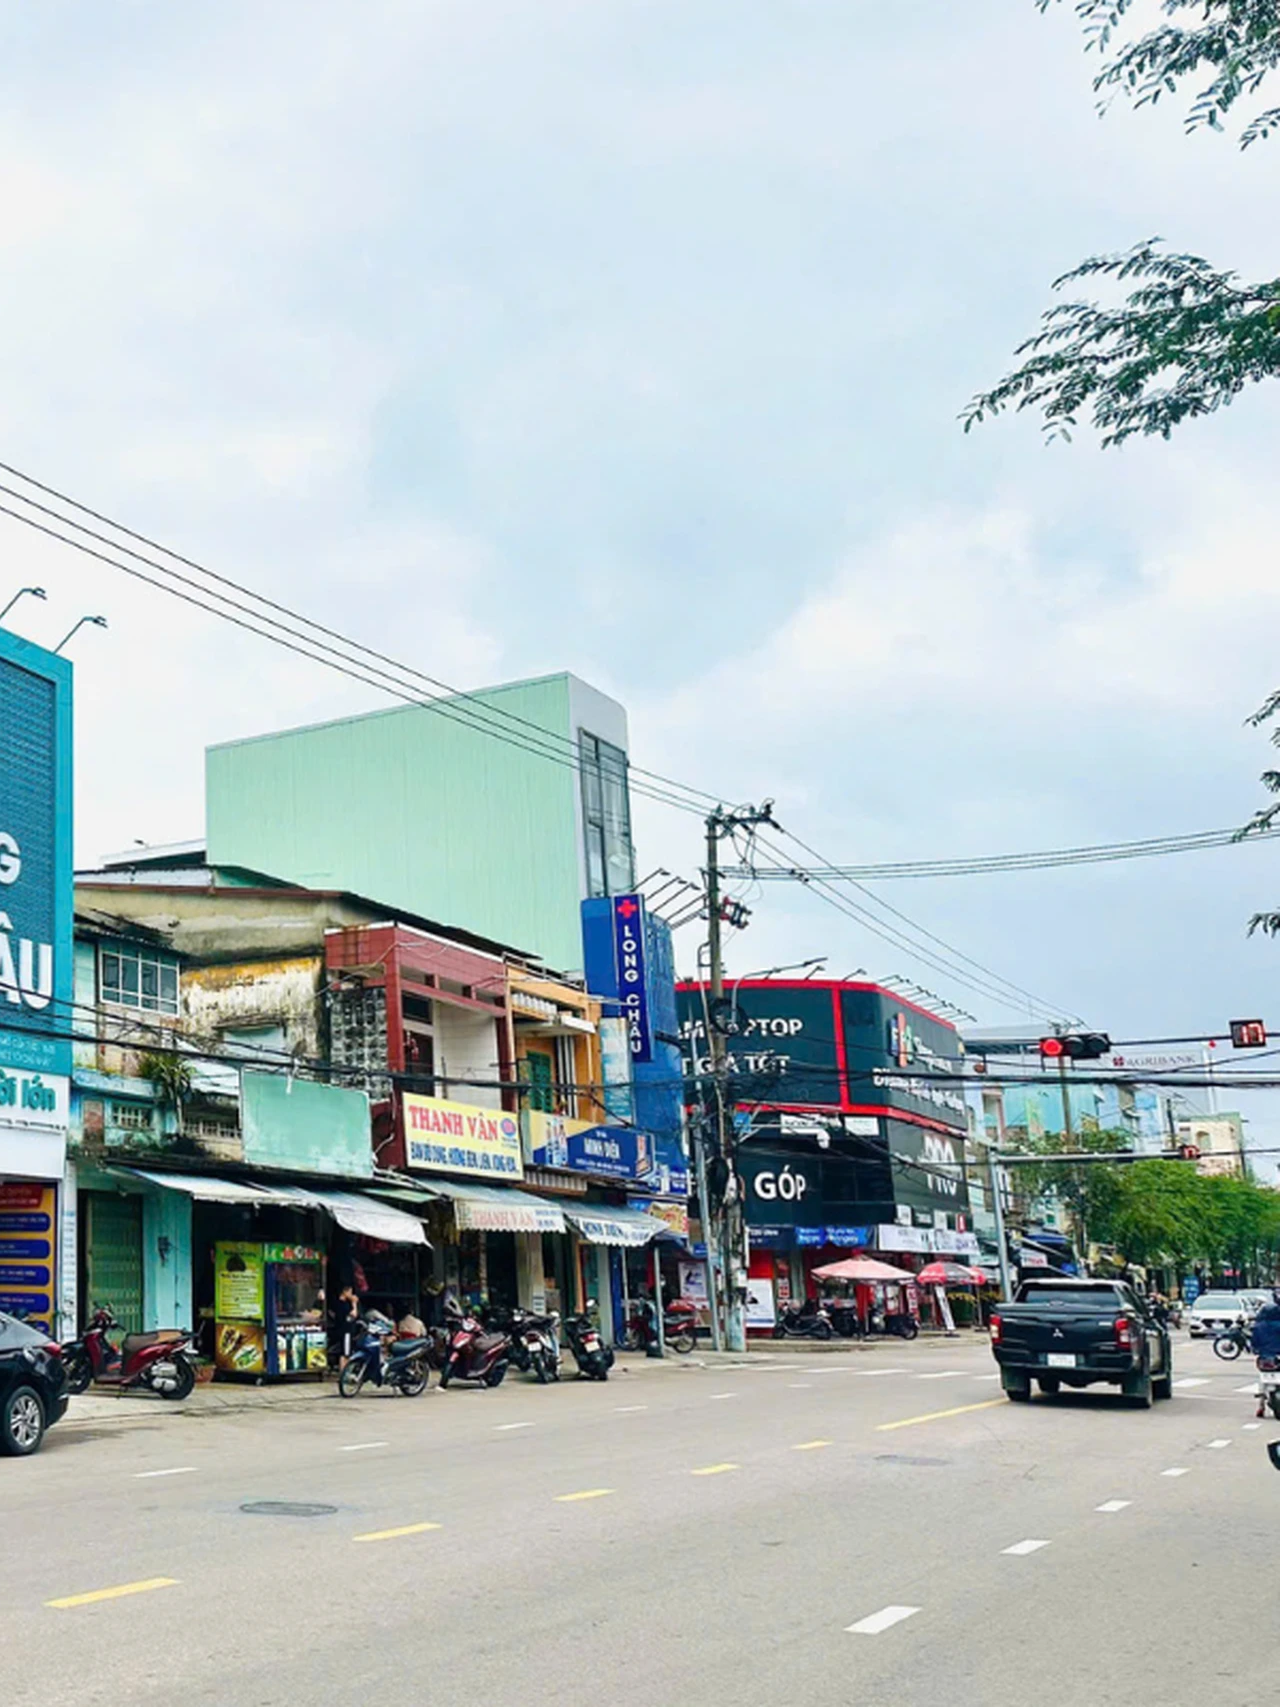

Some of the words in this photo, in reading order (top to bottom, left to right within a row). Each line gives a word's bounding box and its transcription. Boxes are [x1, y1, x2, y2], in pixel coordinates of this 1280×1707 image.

[622, 925, 639, 983] LONG
[1126, 1055, 1196, 1067] AGRIBANK
[22, 1075, 56, 1112] lớn
[408, 1105, 463, 1137] THANH
[467, 1112, 498, 1141] VÂN
[754, 1164, 807, 1201] GÓP
